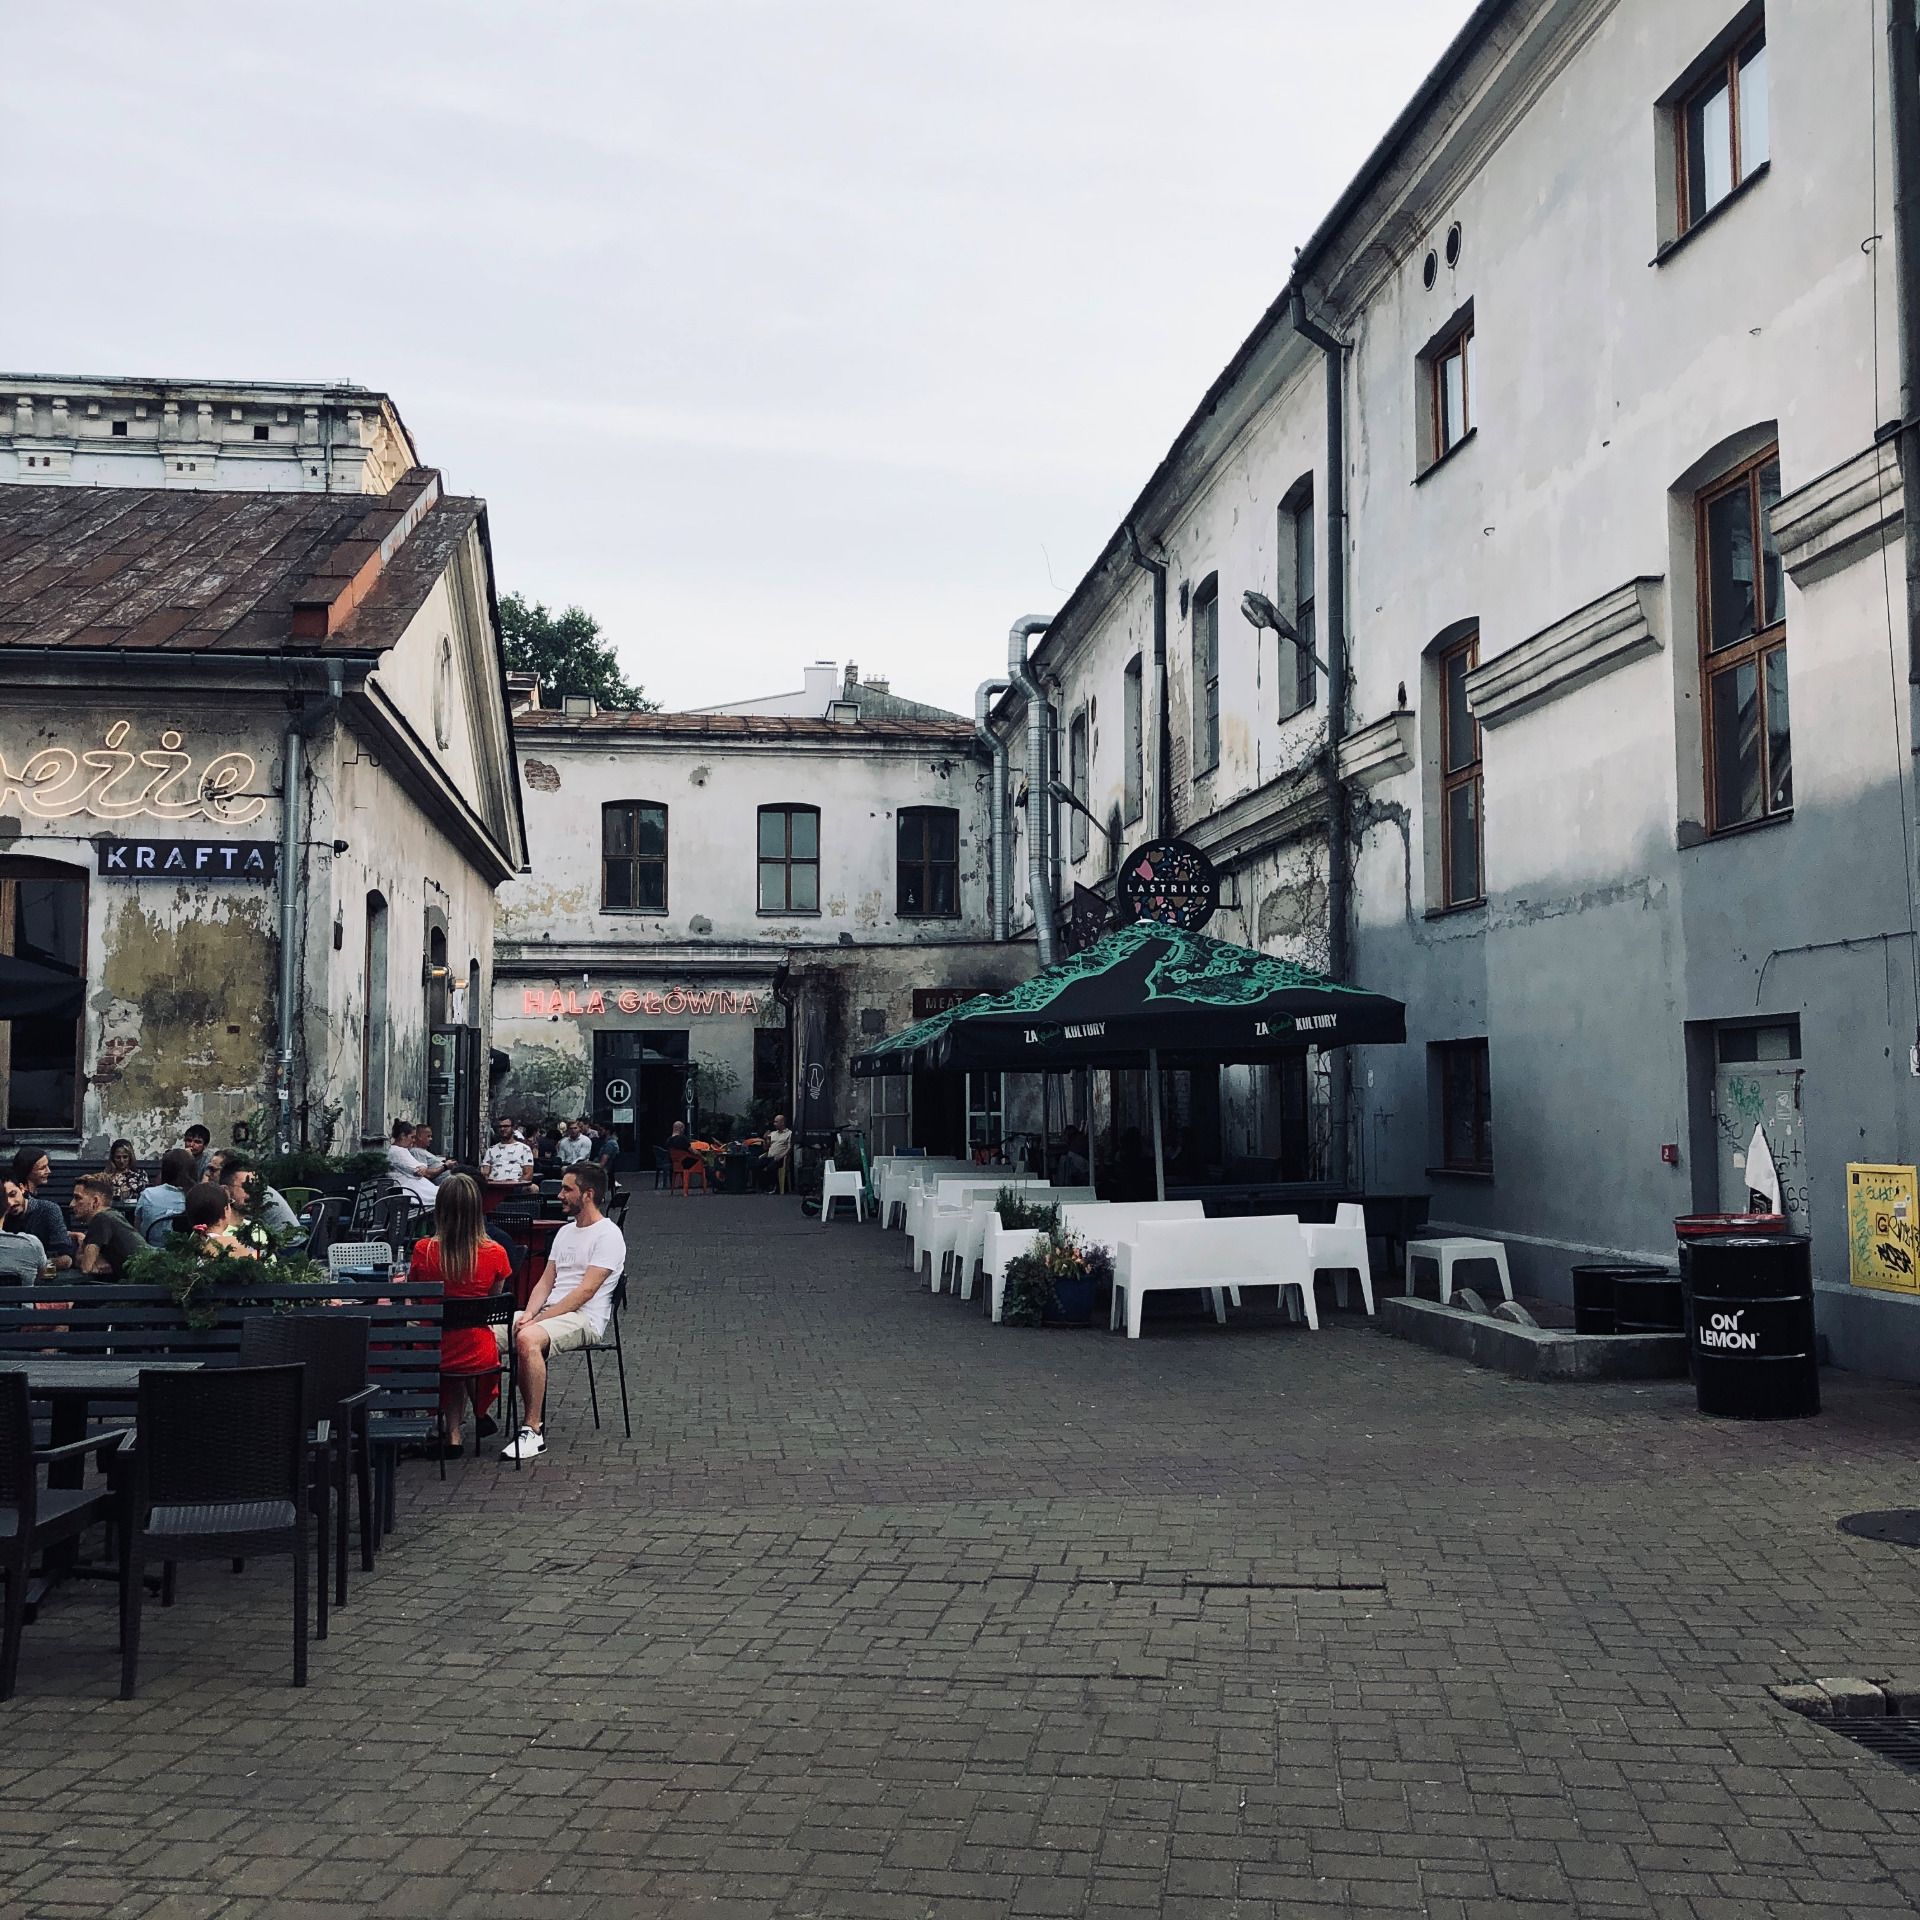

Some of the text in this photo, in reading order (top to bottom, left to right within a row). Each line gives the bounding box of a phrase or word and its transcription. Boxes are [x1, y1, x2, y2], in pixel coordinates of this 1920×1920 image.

[0, 720, 266, 824] eźże
[107, 846, 265, 869] KRAFTA
[1127, 884, 1211, 893] LASTRIKO
[523, 986, 758, 1014] HALA GŁÓWNA
[1023, 1030, 1038, 1043] ZA
[1064, 1022, 1106, 1039] KULTURY
[1254, 1022, 1269, 1036] ZA
[1295, 1014, 1337, 1031] KULTURY
[613, 1085, 624, 1098] H
[1711, 1312, 1738, 1331] ON
[1700, 1326, 1756, 1349] LEMON
